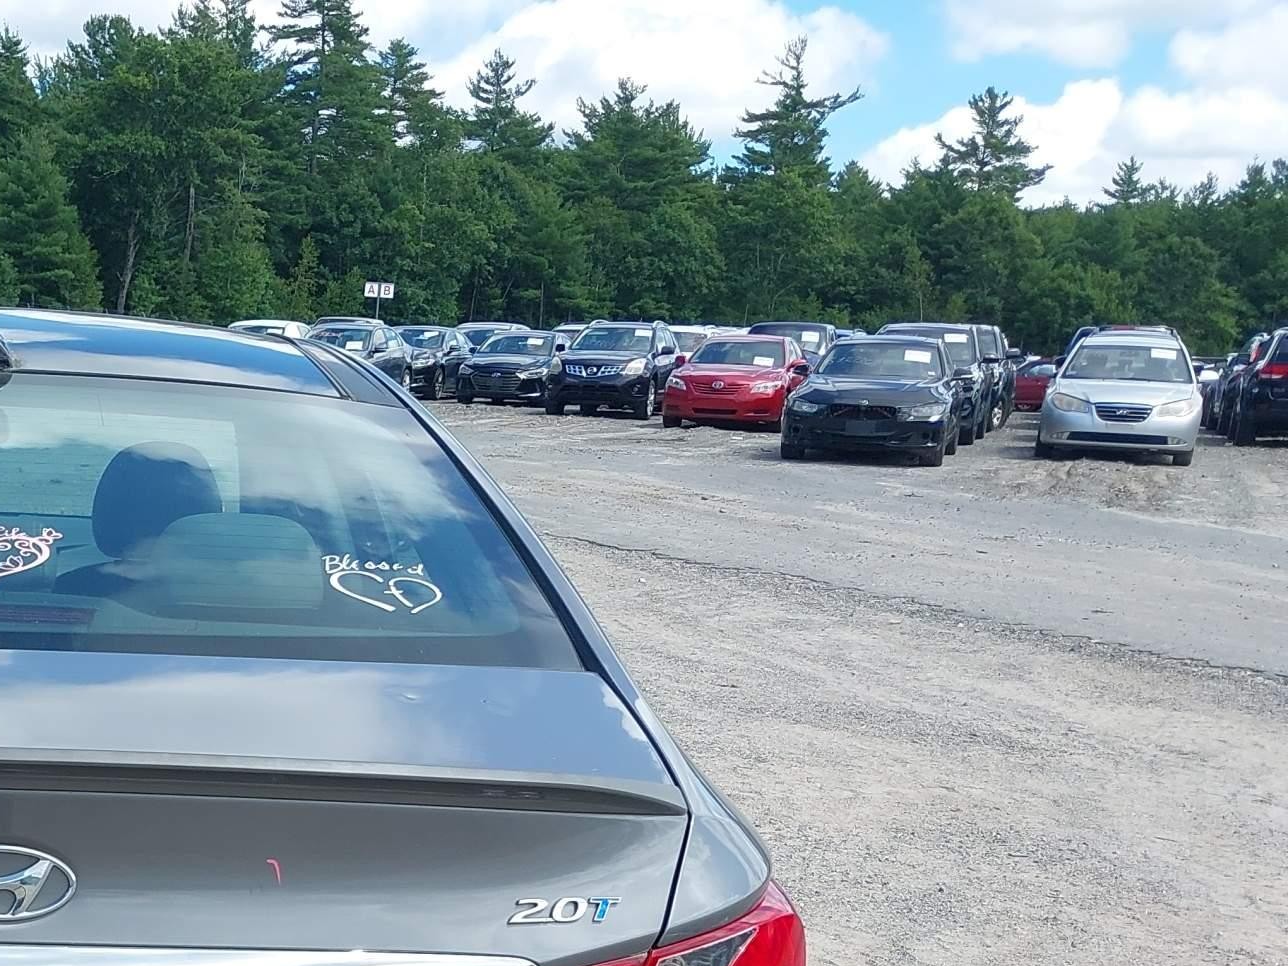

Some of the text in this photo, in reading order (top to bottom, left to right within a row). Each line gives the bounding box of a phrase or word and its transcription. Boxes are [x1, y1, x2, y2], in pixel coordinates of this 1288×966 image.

[367, 285, 375, 295] A
[383, 285, 391, 296] B
[321, 553, 425, 576] Blessed
